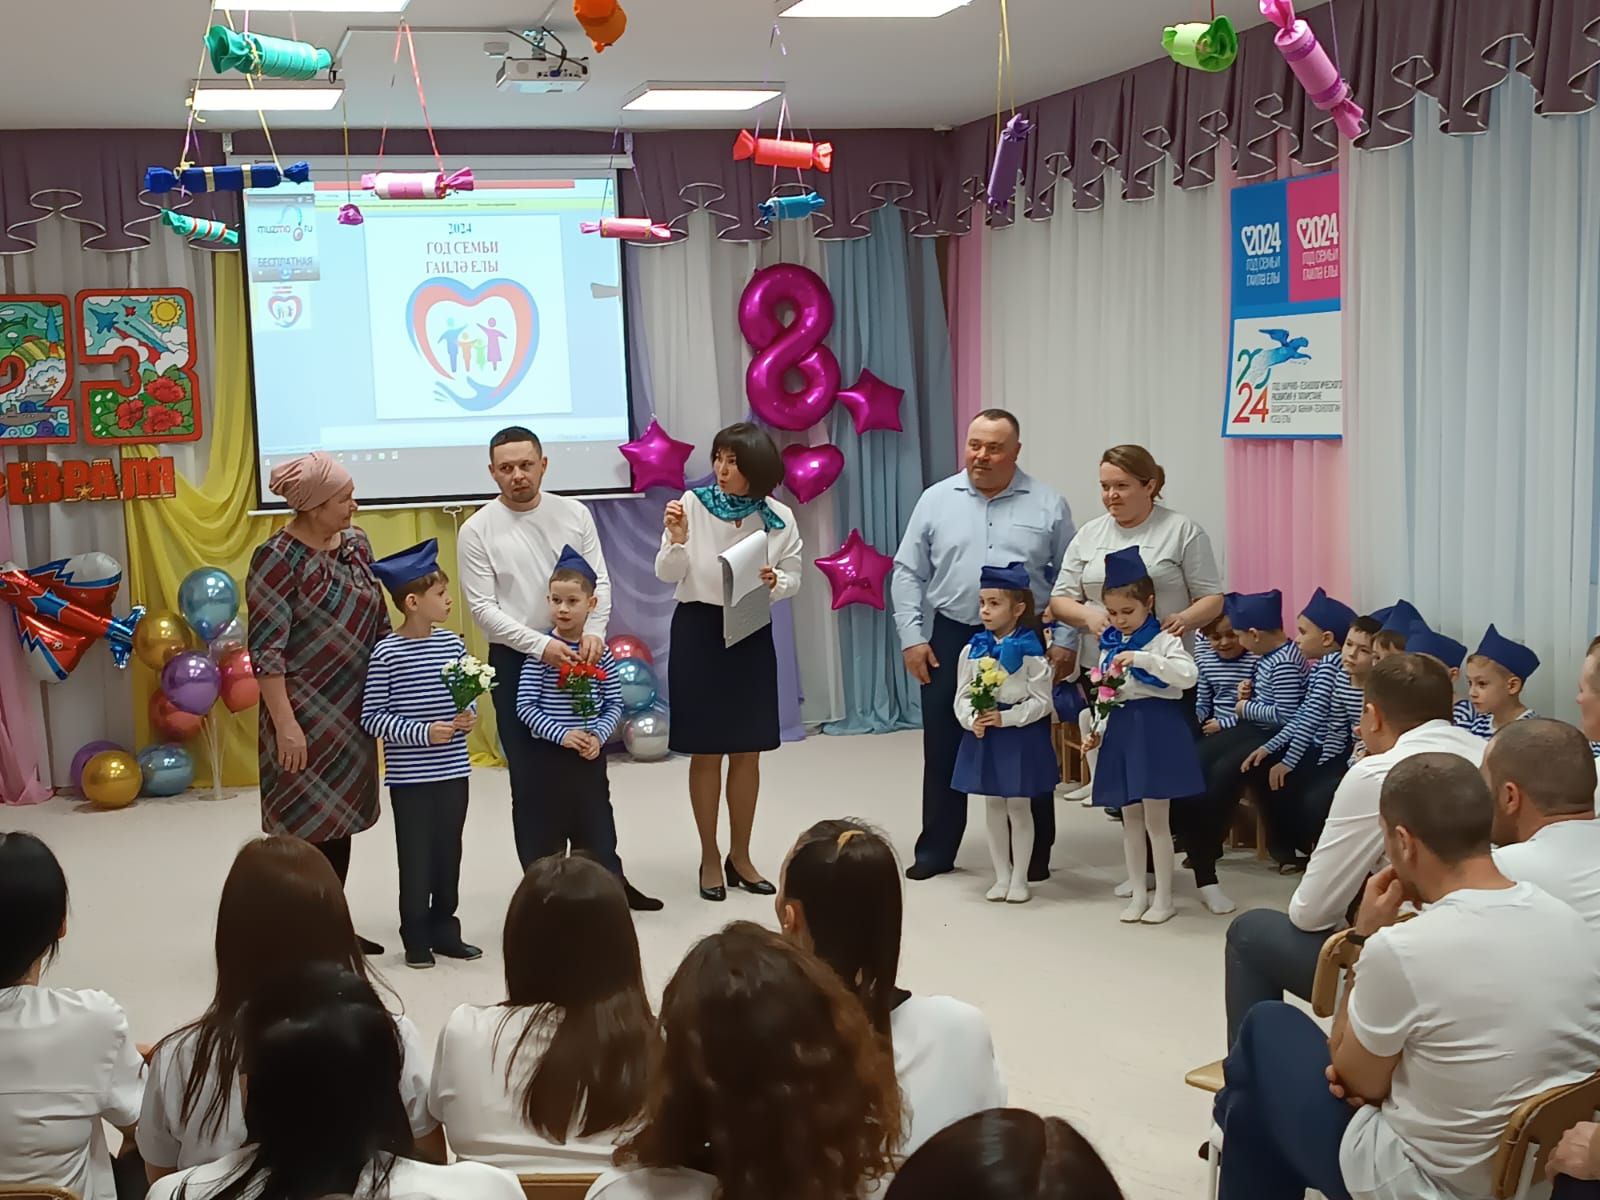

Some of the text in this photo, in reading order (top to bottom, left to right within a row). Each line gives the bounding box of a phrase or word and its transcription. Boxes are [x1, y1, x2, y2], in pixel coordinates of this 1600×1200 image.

[448, 223, 472, 235] 2024
[1296, 212, 1339, 249] 2024
[1241, 222, 1282, 256] 2024
[426, 241, 499, 255] ГОД СЕМЬИ
[258, 256, 313, 267] БЕСПЛАТНАЯ
[471, 260, 499, 273] ЕЛЫ
[0, 457, 176, 505] ЕВРАЛЯ
